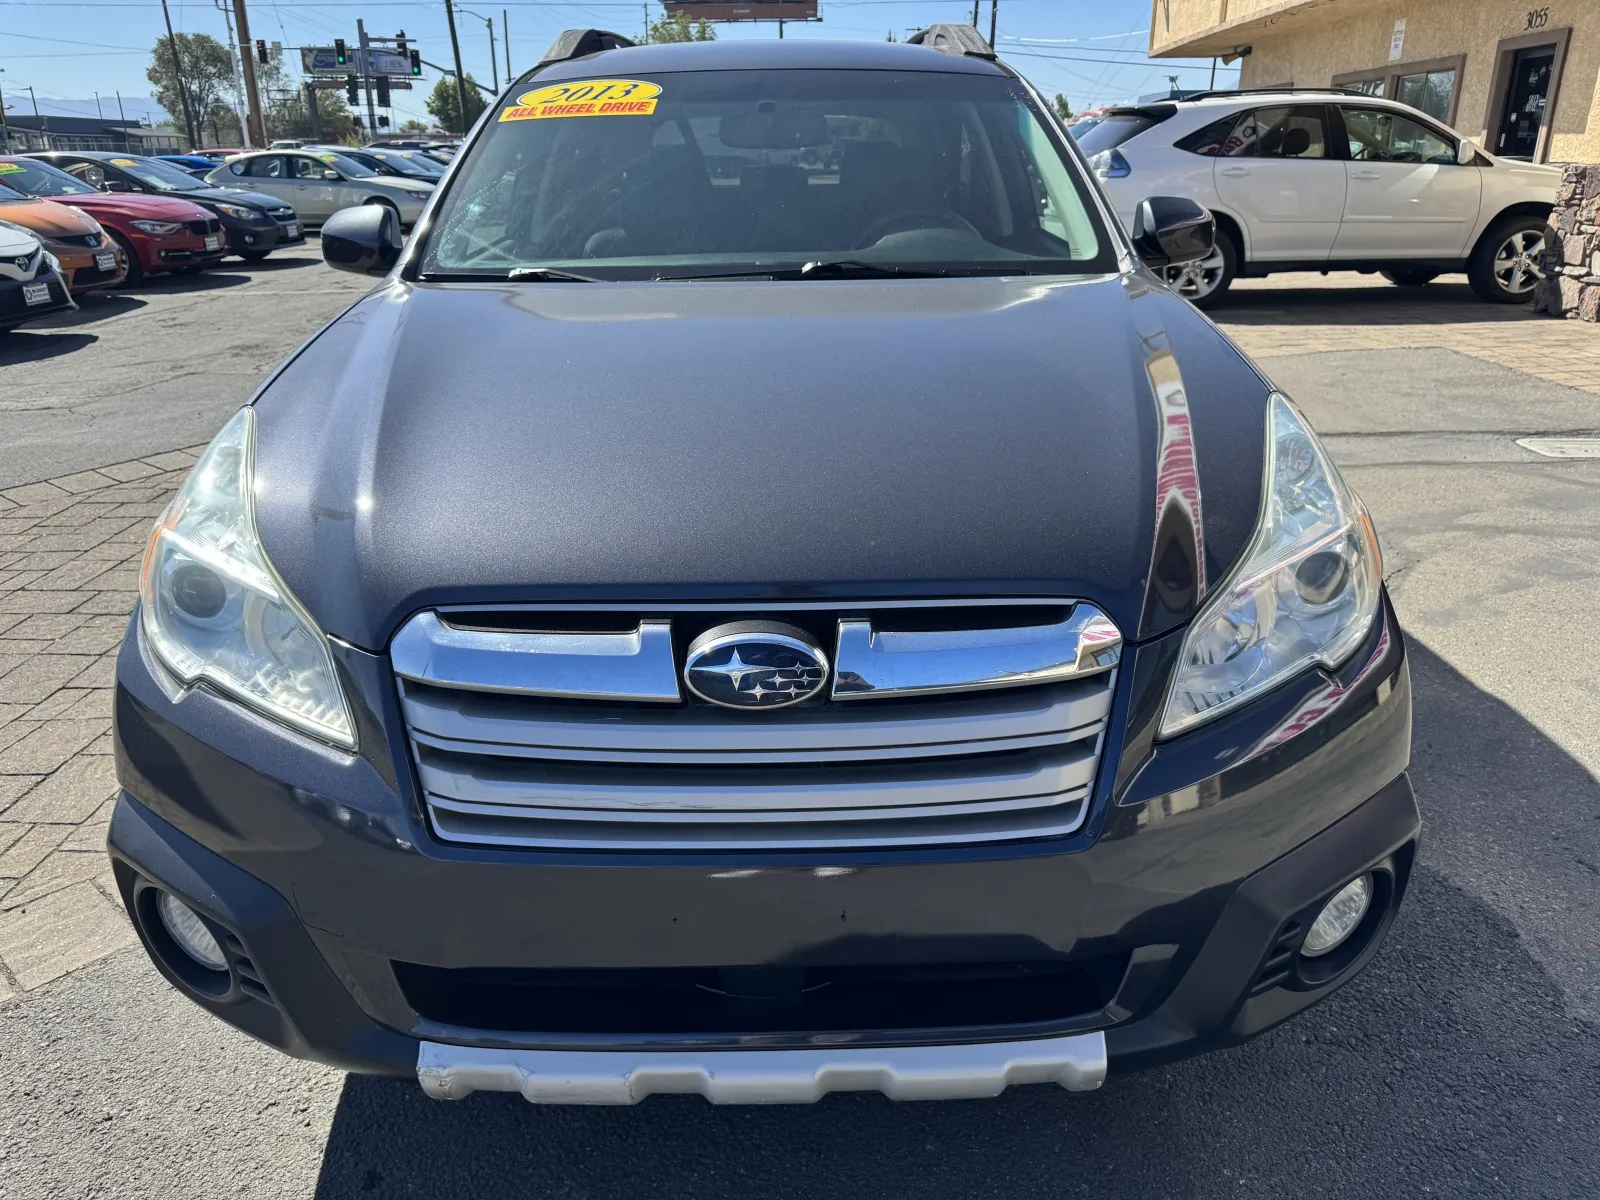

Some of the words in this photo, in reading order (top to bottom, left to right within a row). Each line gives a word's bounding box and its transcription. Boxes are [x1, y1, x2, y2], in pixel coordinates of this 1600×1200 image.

[1524, 7, 1549, 31] 3055
[538, 84, 639, 104] 2013
[506, 107, 537, 120] ALL
[540, 103, 595, 116] WHEEL
[598, 101, 652, 113] DRIVE
